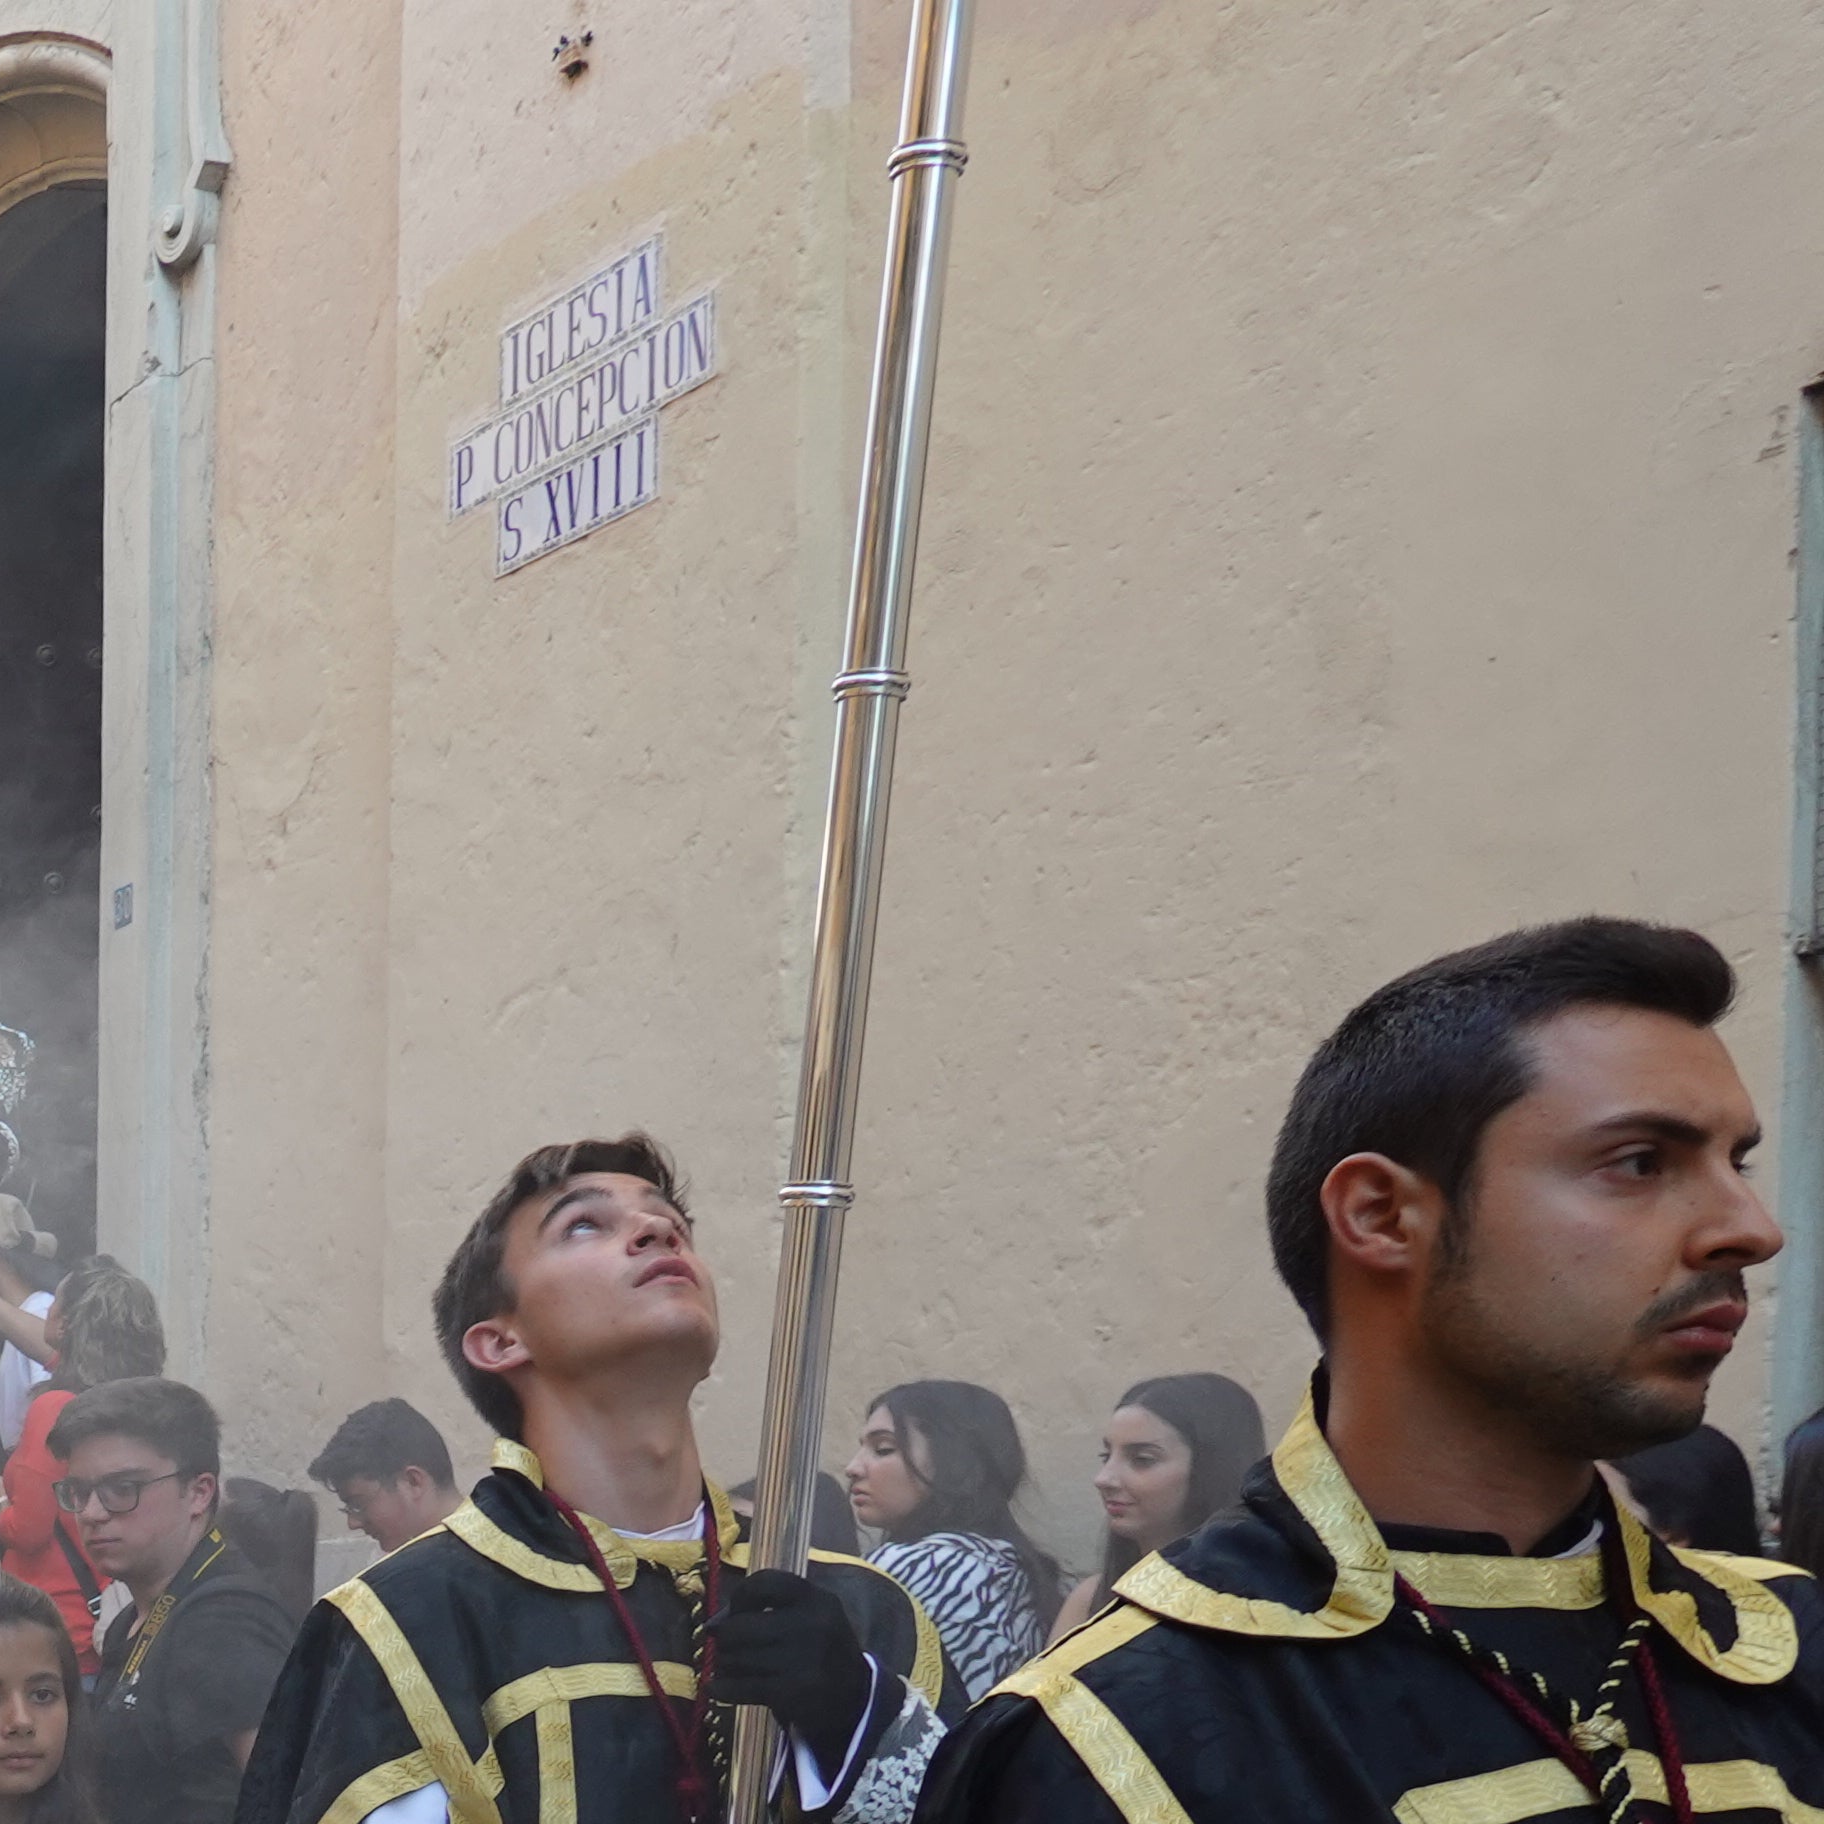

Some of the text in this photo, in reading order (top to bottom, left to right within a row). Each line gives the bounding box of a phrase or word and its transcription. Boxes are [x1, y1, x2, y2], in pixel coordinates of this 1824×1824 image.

[510, 252, 653, 396] IGLESIA
[455, 302, 711, 511] P CONCEPCION
[502, 430, 646, 563] S XVIII
